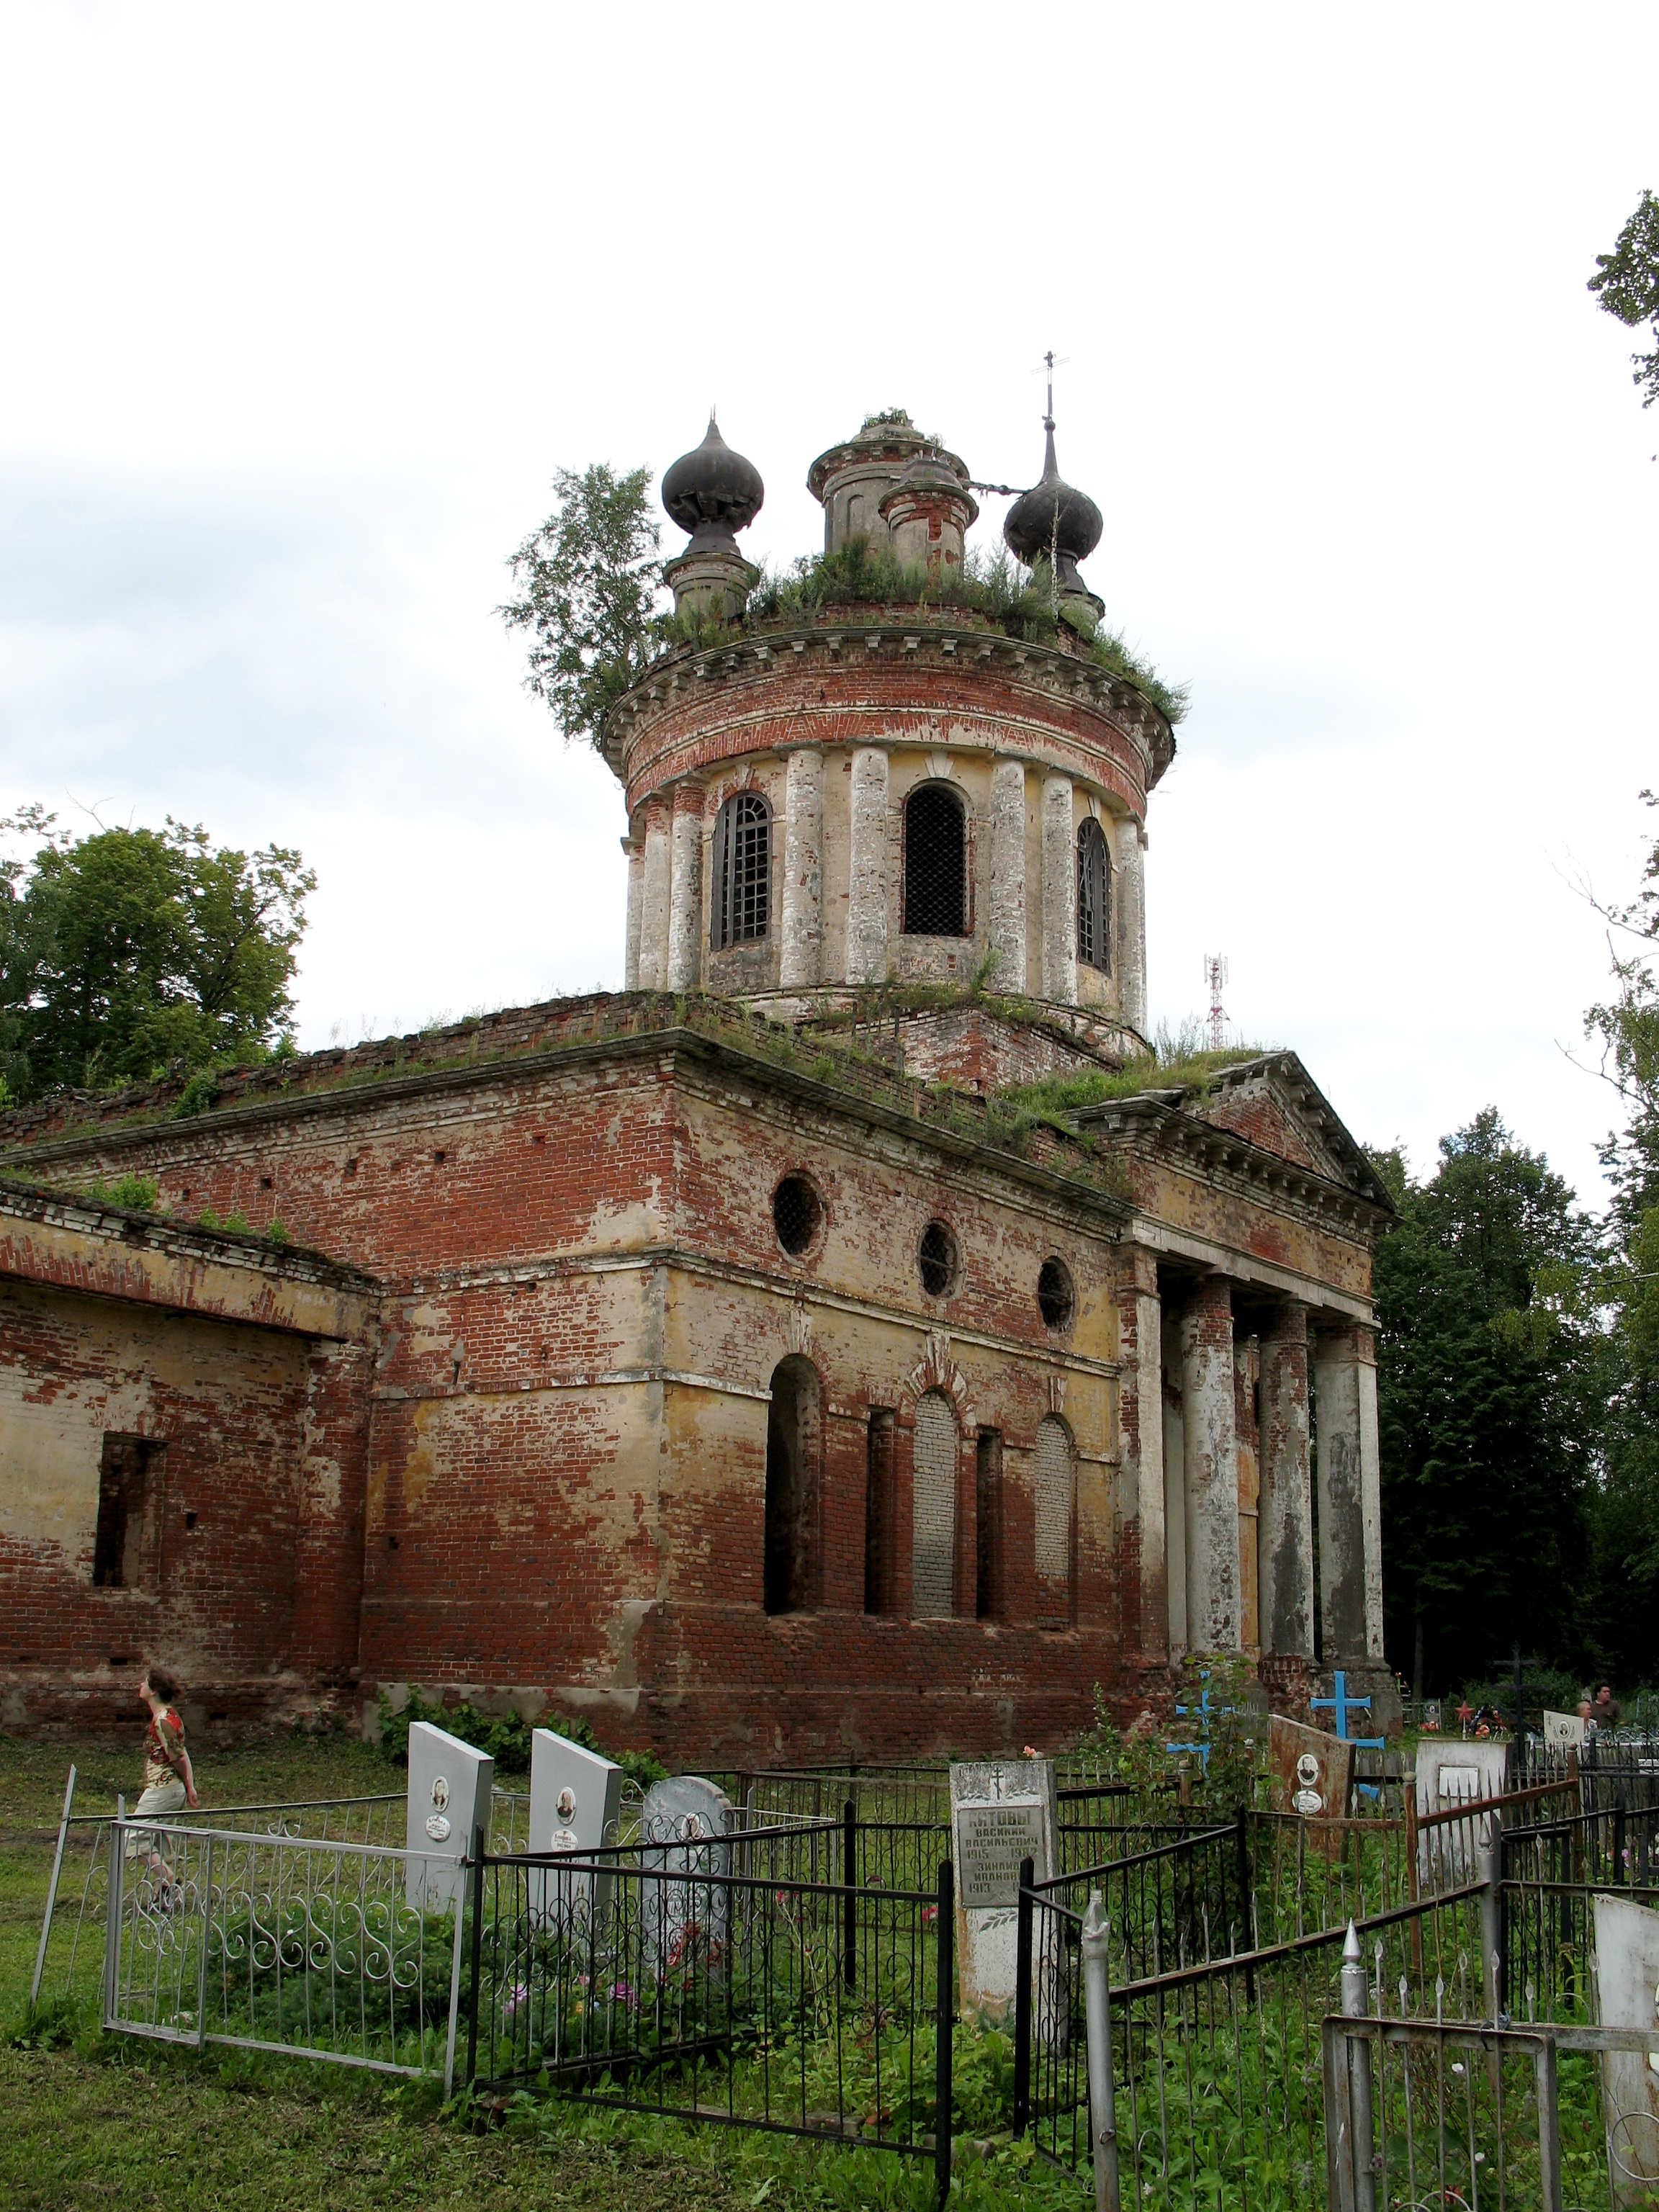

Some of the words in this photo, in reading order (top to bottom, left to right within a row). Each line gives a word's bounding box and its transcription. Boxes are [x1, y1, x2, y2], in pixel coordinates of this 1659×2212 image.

[966, 1836, 1038, 1848] ВАСИЛЬЕВИЧ
[967, 1848, 989, 1859] 1915
[978, 1861, 1020, 1871] ЗИНАИД
